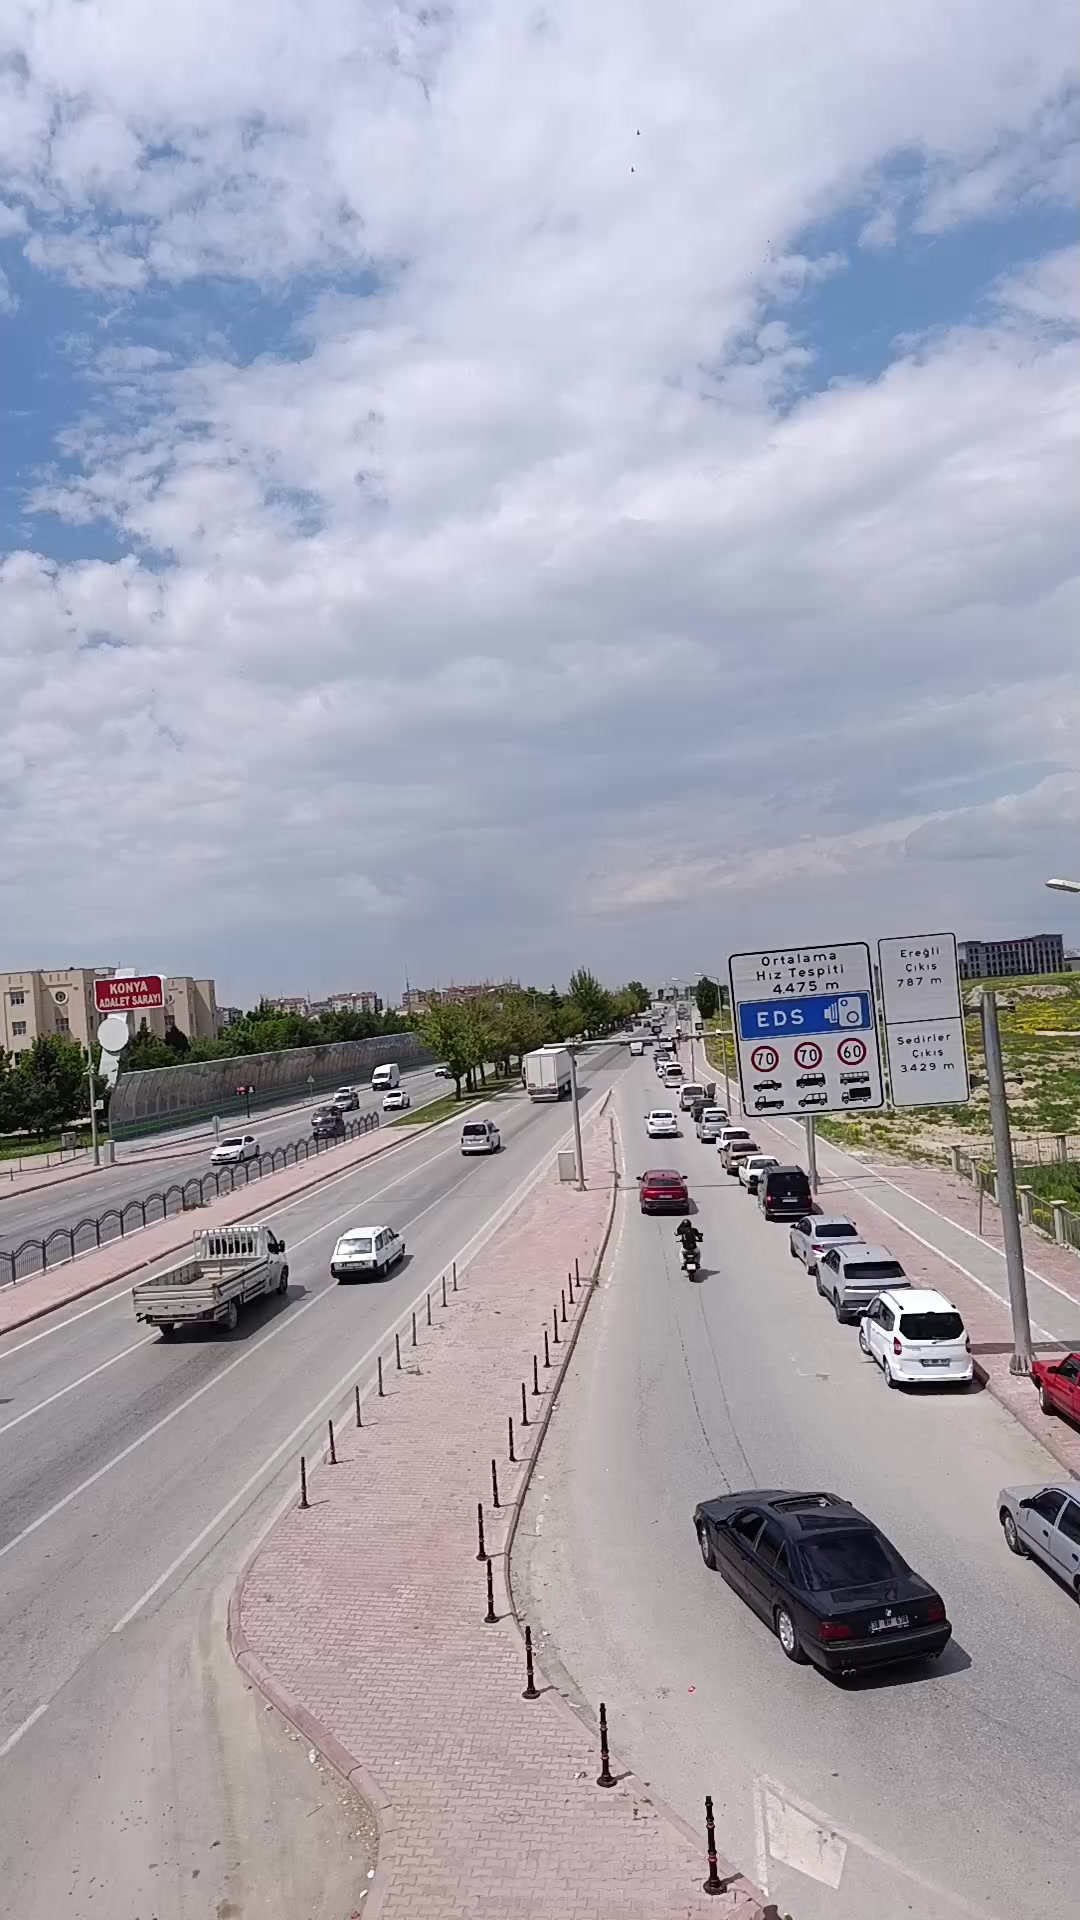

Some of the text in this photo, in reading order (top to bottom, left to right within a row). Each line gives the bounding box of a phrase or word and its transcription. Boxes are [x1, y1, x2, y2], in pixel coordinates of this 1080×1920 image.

[900, 947, 939, 958] Ereğli
[761, 953, 837, 966] Ortalama
[756, 964, 844, 981] Hız Tespiti
[109, 981, 148, 994] KONYA
[773, 981, 839, 994] 4.475 m
[897, 977, 923, 987] 787
[99, 993, 161, 1008] ADALET SARAYI
[757, 1009, 804, 1028] EDS
[897, 1034, 951, 1045] Sedirler
[799, 1049, 818, 1063] 70
[843, 1045, 861, 1059] 60
[756, 1052, 774, 1066] 70
